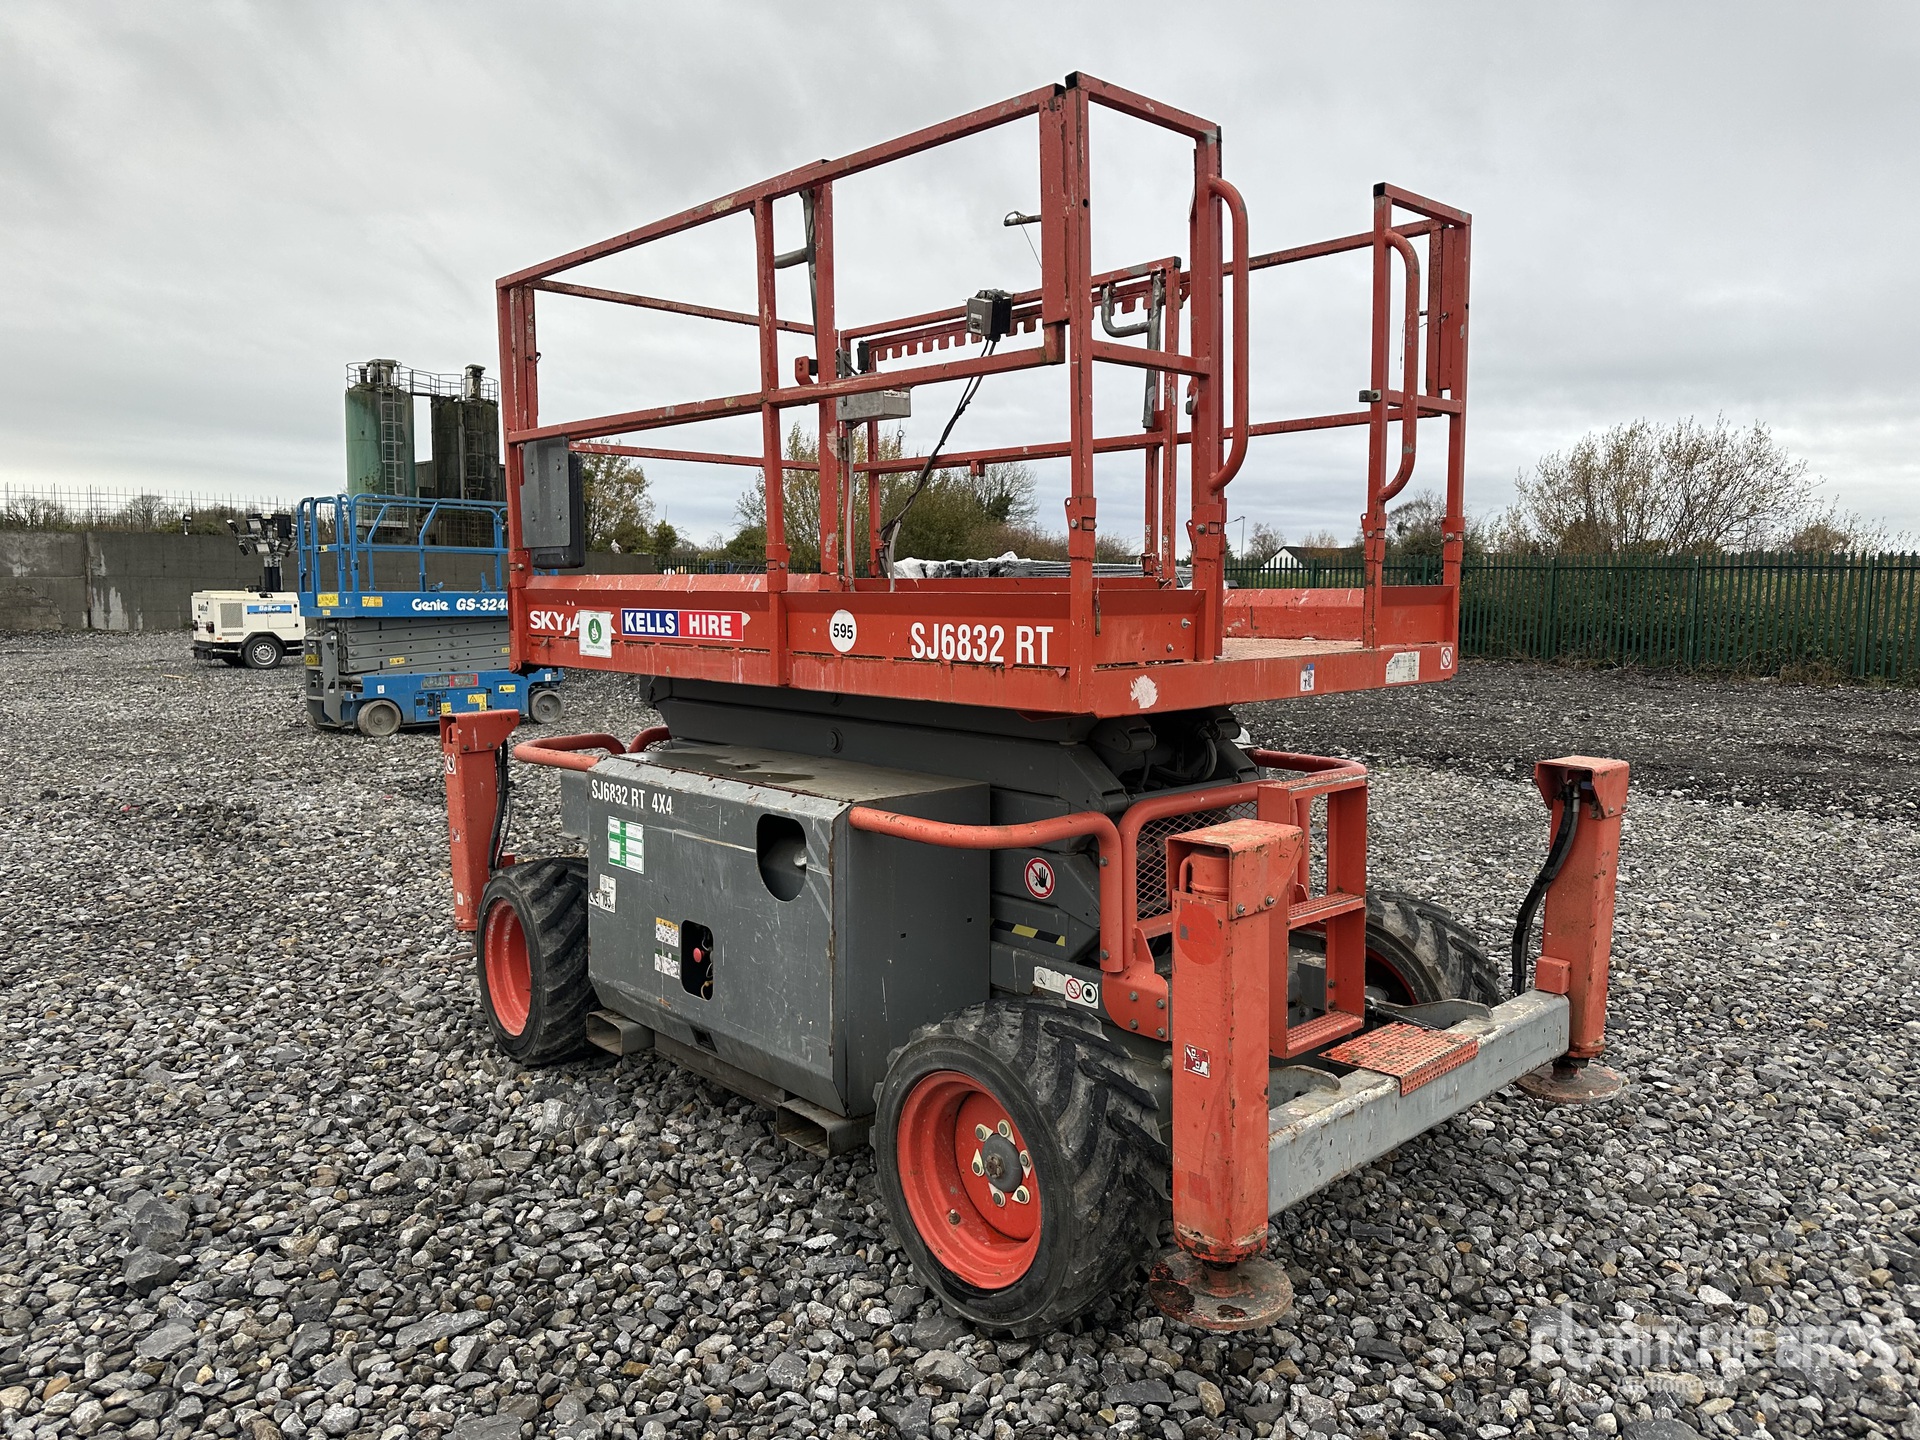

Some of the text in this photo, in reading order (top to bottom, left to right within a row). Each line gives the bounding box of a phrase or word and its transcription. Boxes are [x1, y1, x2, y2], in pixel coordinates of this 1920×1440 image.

[412, 598, 448, 611] Genie
[624, 612, 732, 636] KELLS HIRE
[832, 622, 854, 640] 595
[911, 622, 1054, 665] SJ6832 RT
[591, 779, 673, 815] SJ6832 RT 4X4
